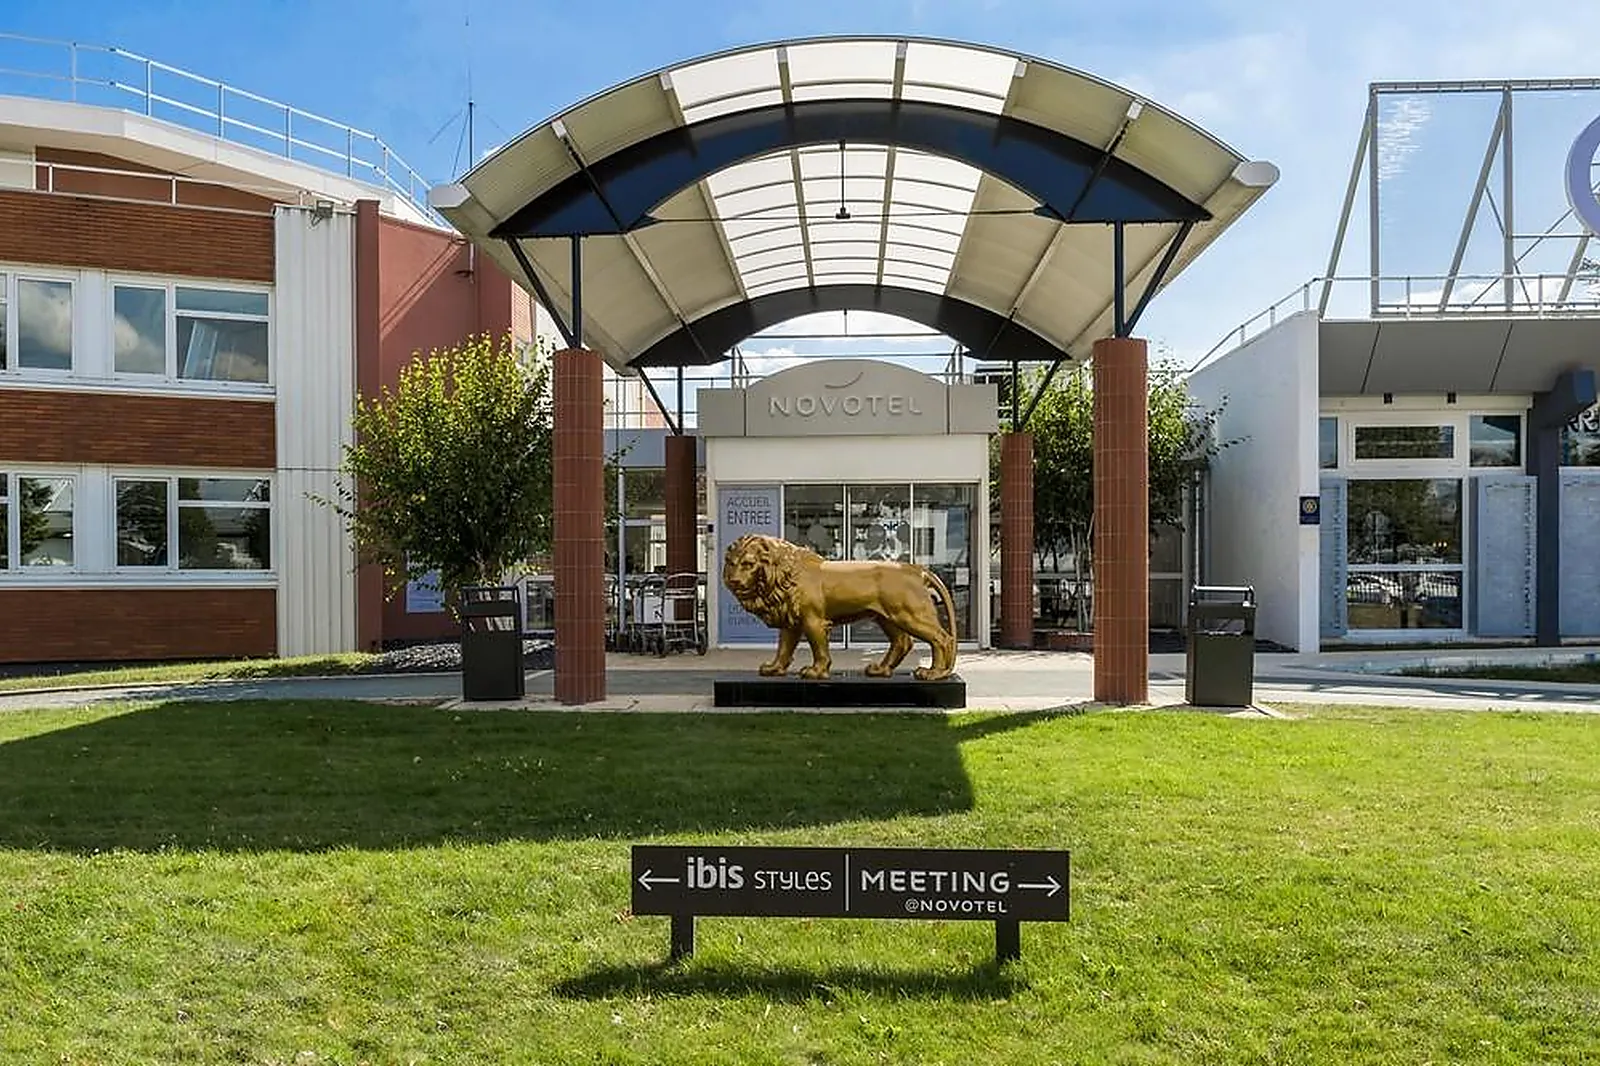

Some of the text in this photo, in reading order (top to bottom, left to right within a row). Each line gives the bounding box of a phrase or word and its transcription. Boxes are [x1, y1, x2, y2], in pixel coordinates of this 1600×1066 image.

[768, 396, 923, 417] NOVOTEL
[727, 497, 771, 507] ACCUEIL
[686, 857, 744, 890] ibis
[861, 870, 1010, 894] MEETING
[905, 899, 1008, 915] @NOVOTEL
